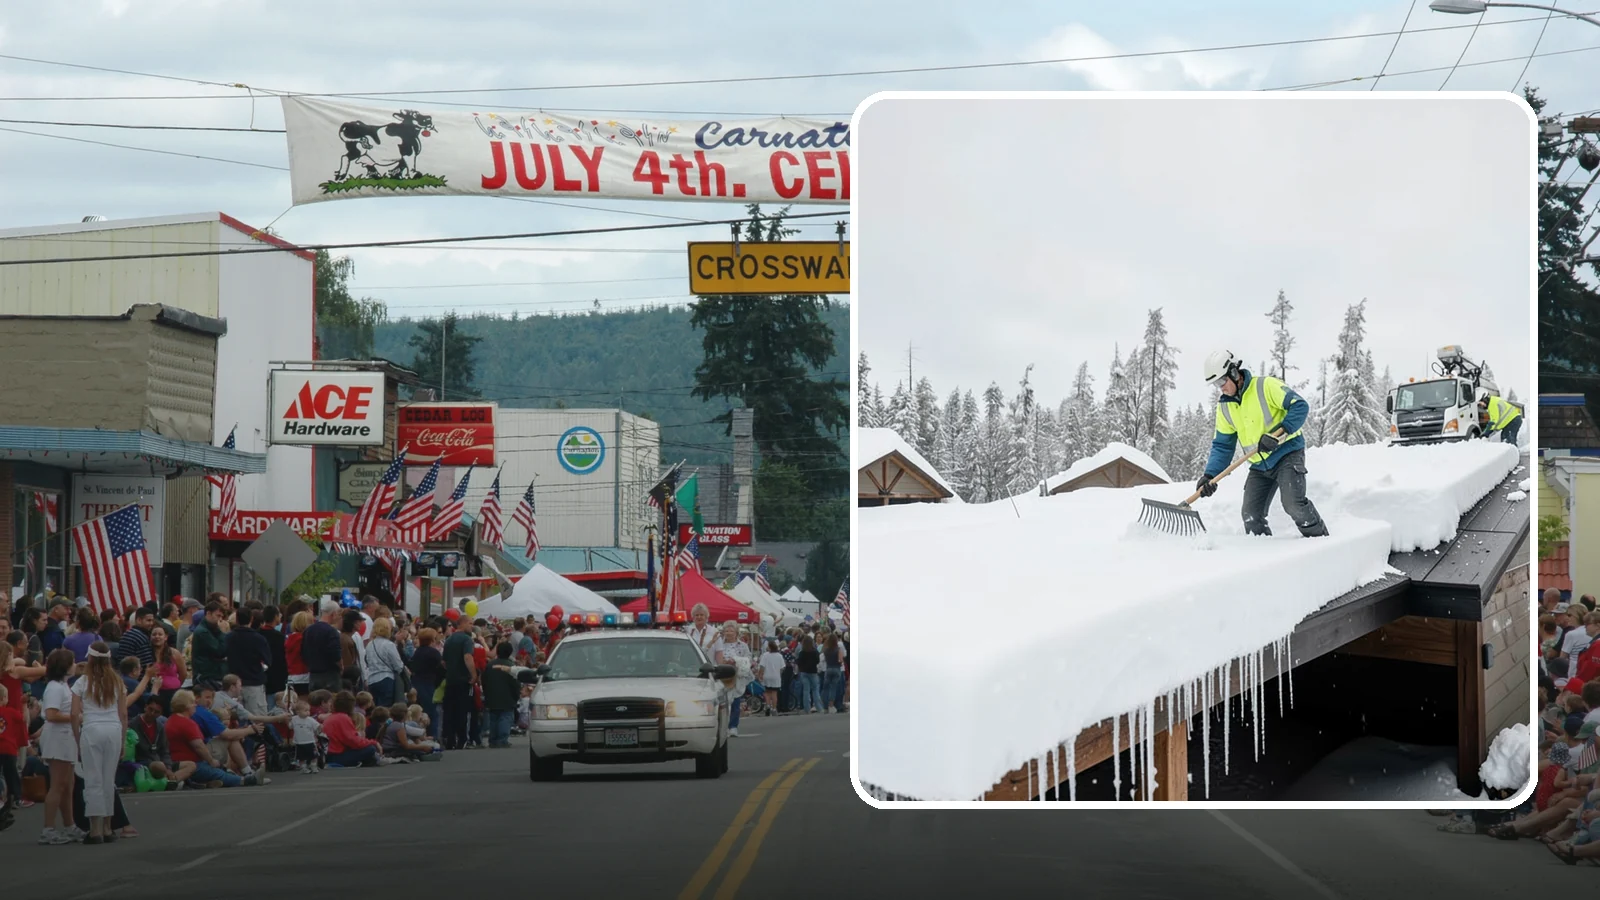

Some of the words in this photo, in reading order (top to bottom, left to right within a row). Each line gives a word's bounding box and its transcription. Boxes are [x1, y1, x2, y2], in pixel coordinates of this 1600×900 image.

[481, 141, 604, 192] JULY
[632, 149, 746, 197] 4th.
[697, 254, 850, 280] CROSSWA
[283, 380, 373, 420] ACE
[405, 408, 452, 422] CEDAR
[283, 421, 371, 436] Hardware
[95, 485, 124, 495] Vincent
[126, 485, 136, 495] de
[137, 486, 155, 496] Paul
[212, 516, 330, 535] HARDARE
[688, 526, 741, 535] CRNATION
[699, 535, 730, 544] GLASS
